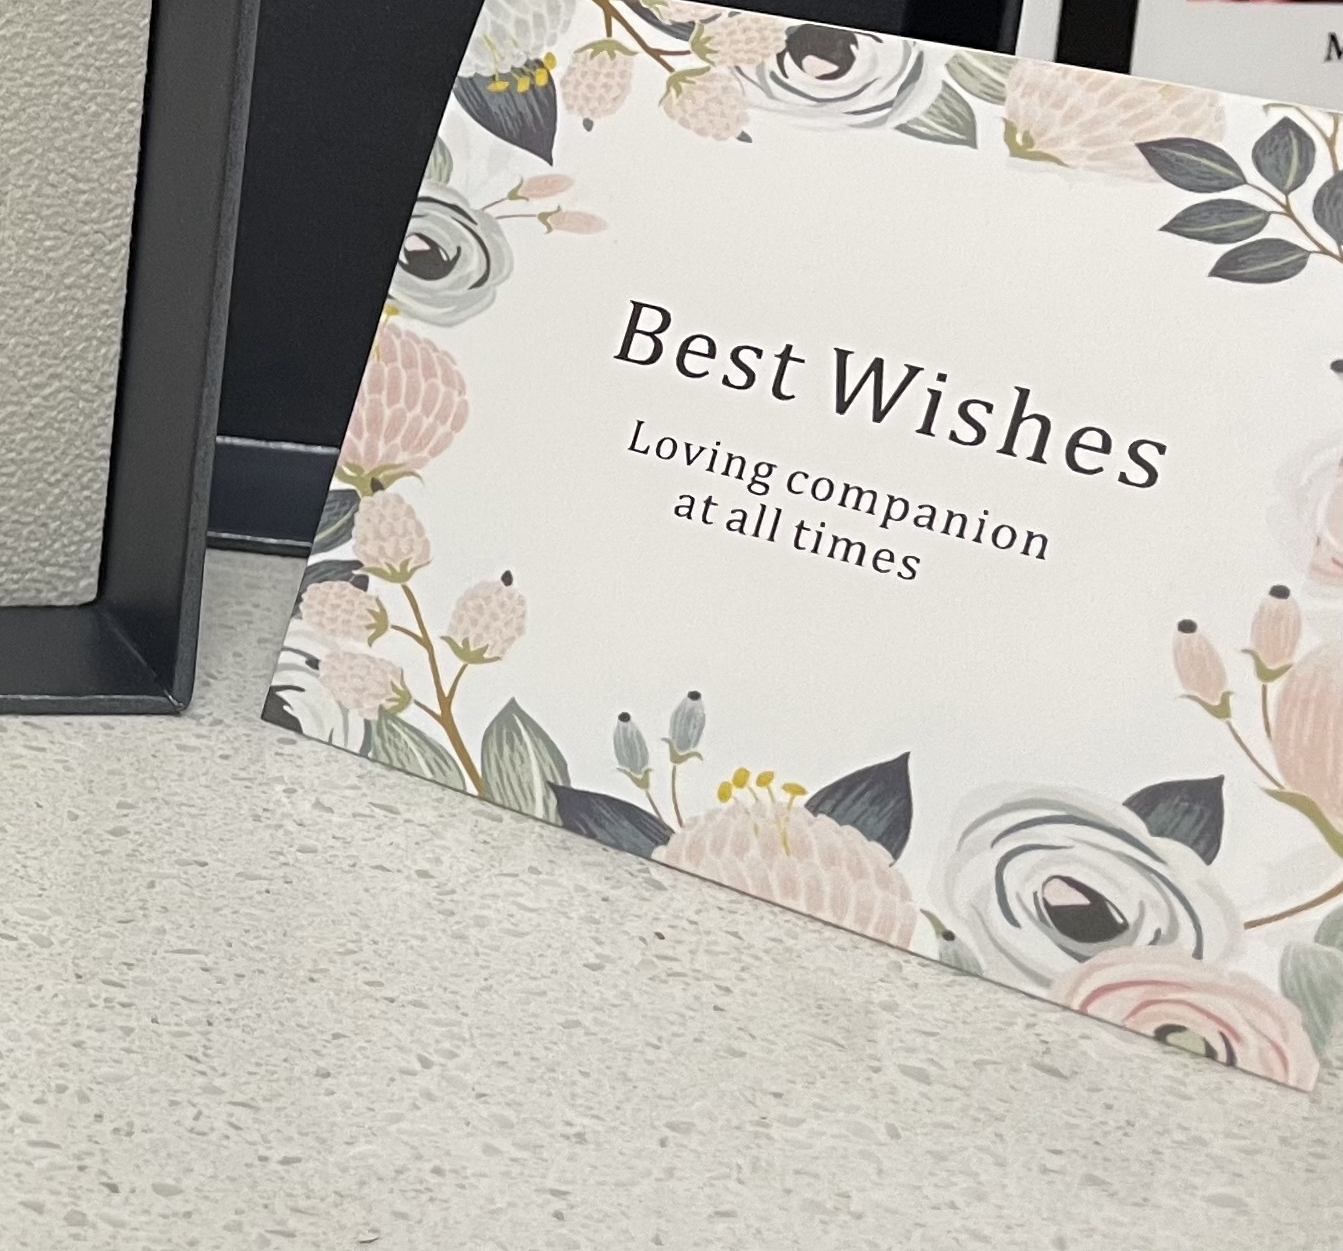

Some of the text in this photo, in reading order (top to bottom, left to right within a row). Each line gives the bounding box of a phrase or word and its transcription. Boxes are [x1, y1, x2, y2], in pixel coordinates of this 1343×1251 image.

[613, 299, 1167, 489] Best Wishes
[627, 419, 1049, 561] Loving companion
[674, 494, 921, 581] at all times
